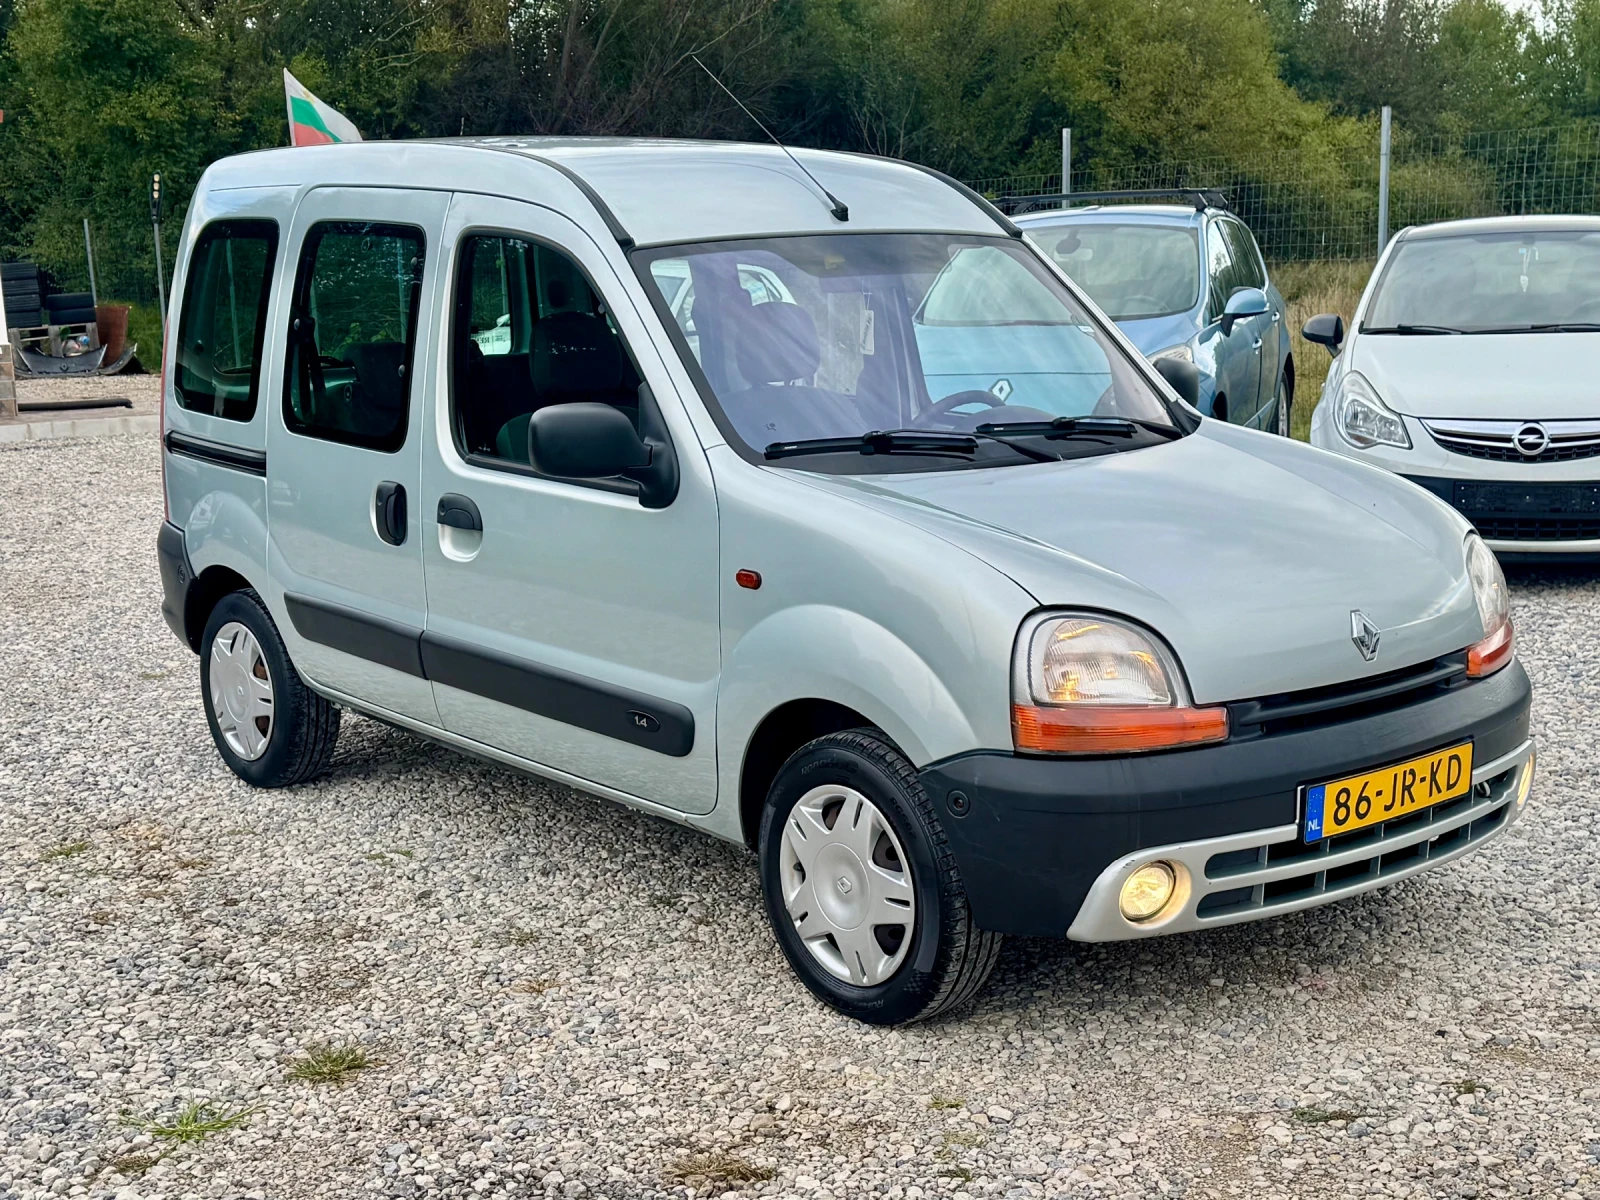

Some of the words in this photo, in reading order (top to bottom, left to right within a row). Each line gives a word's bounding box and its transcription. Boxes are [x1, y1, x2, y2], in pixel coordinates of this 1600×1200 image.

[634, 715, 648, 728] 1.4
[1333, 753, 1462, 827] 86-JR-KD
[1307, 818, 1321, 832] NL
